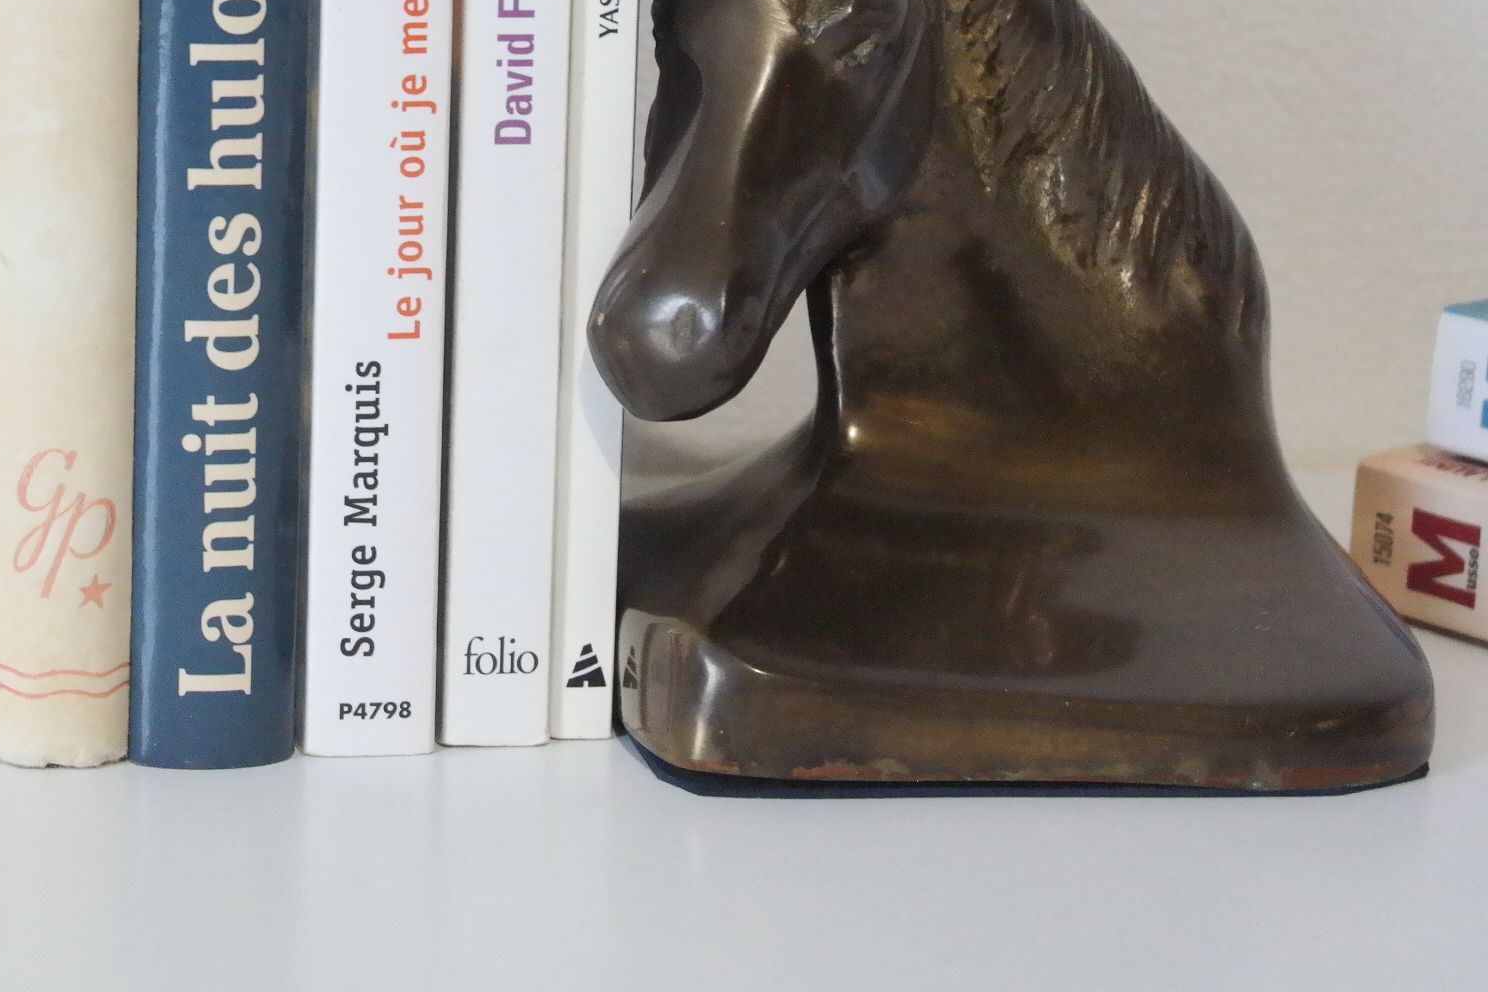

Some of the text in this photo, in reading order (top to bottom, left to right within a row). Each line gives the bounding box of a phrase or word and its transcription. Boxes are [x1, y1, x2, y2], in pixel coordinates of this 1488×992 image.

[391, 74, 437, 114] je
[494, 33, 536, 146] David
[390, 130, 427, 178] où
[387, 194, 433, 281] jour
[184, 212, 263, 371] des
[387, 296, 422, 341] Le
[181, 392, 259, 573] nuit
[340, 360, 389, 658] Serge Marquis
[178, 592, 255, 697] La
[462, 635, 539, 676] folio
[339, 700, 412, 721] P4798
